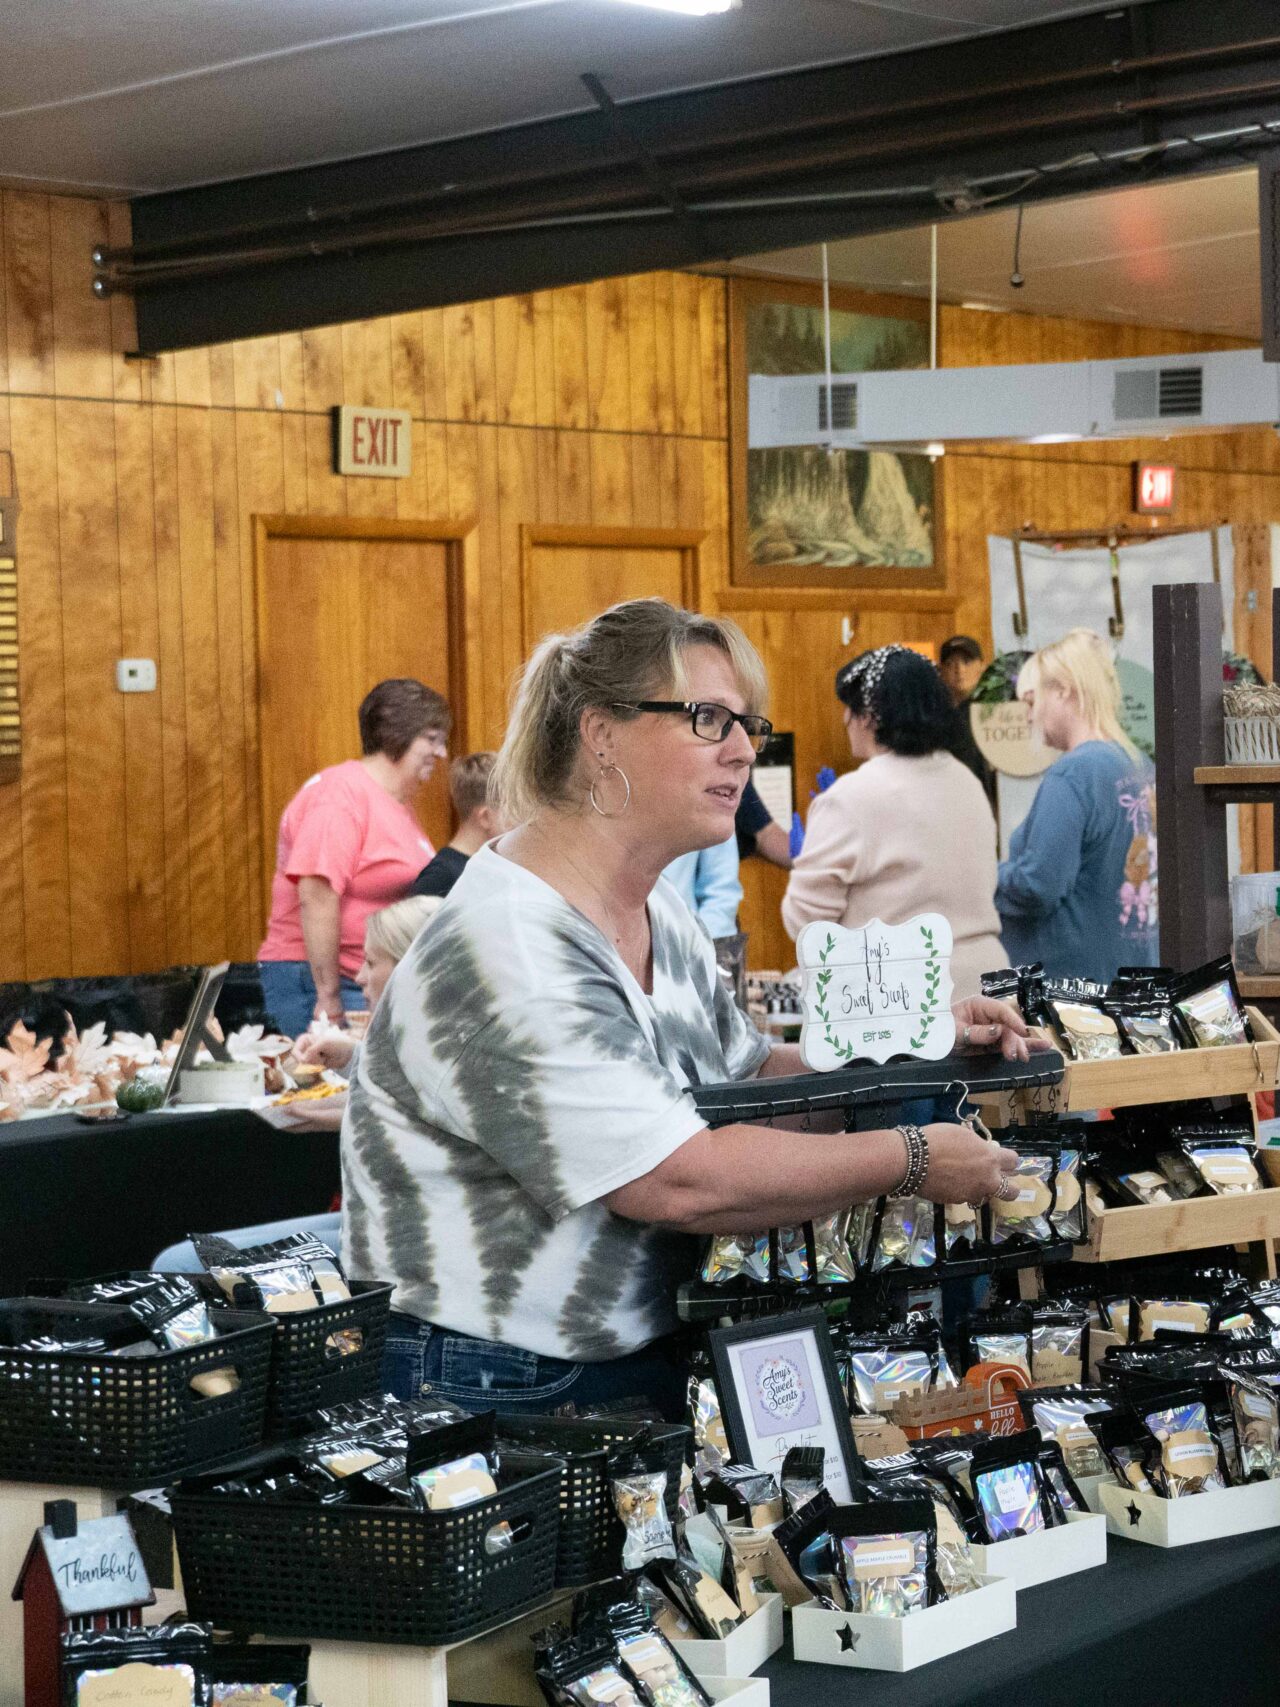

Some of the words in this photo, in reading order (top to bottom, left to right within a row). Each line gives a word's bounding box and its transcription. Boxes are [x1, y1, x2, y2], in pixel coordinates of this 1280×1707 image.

[353, 416, 402, 466] EXIT
[983, 727, 1031, 742] TOGE
[842, 983, 873, 1015] Sweet
[763, 1366, 791, 1389] Amy's
[767, 1382, 794, 1399] Sweet
[769, 1390, 798, 1411] Scents
[991, 1407, 1014, 1419] HELLO
[58, 1552, 136, 1588] Thankful
[140, 1686, 174, 1699] Candy
